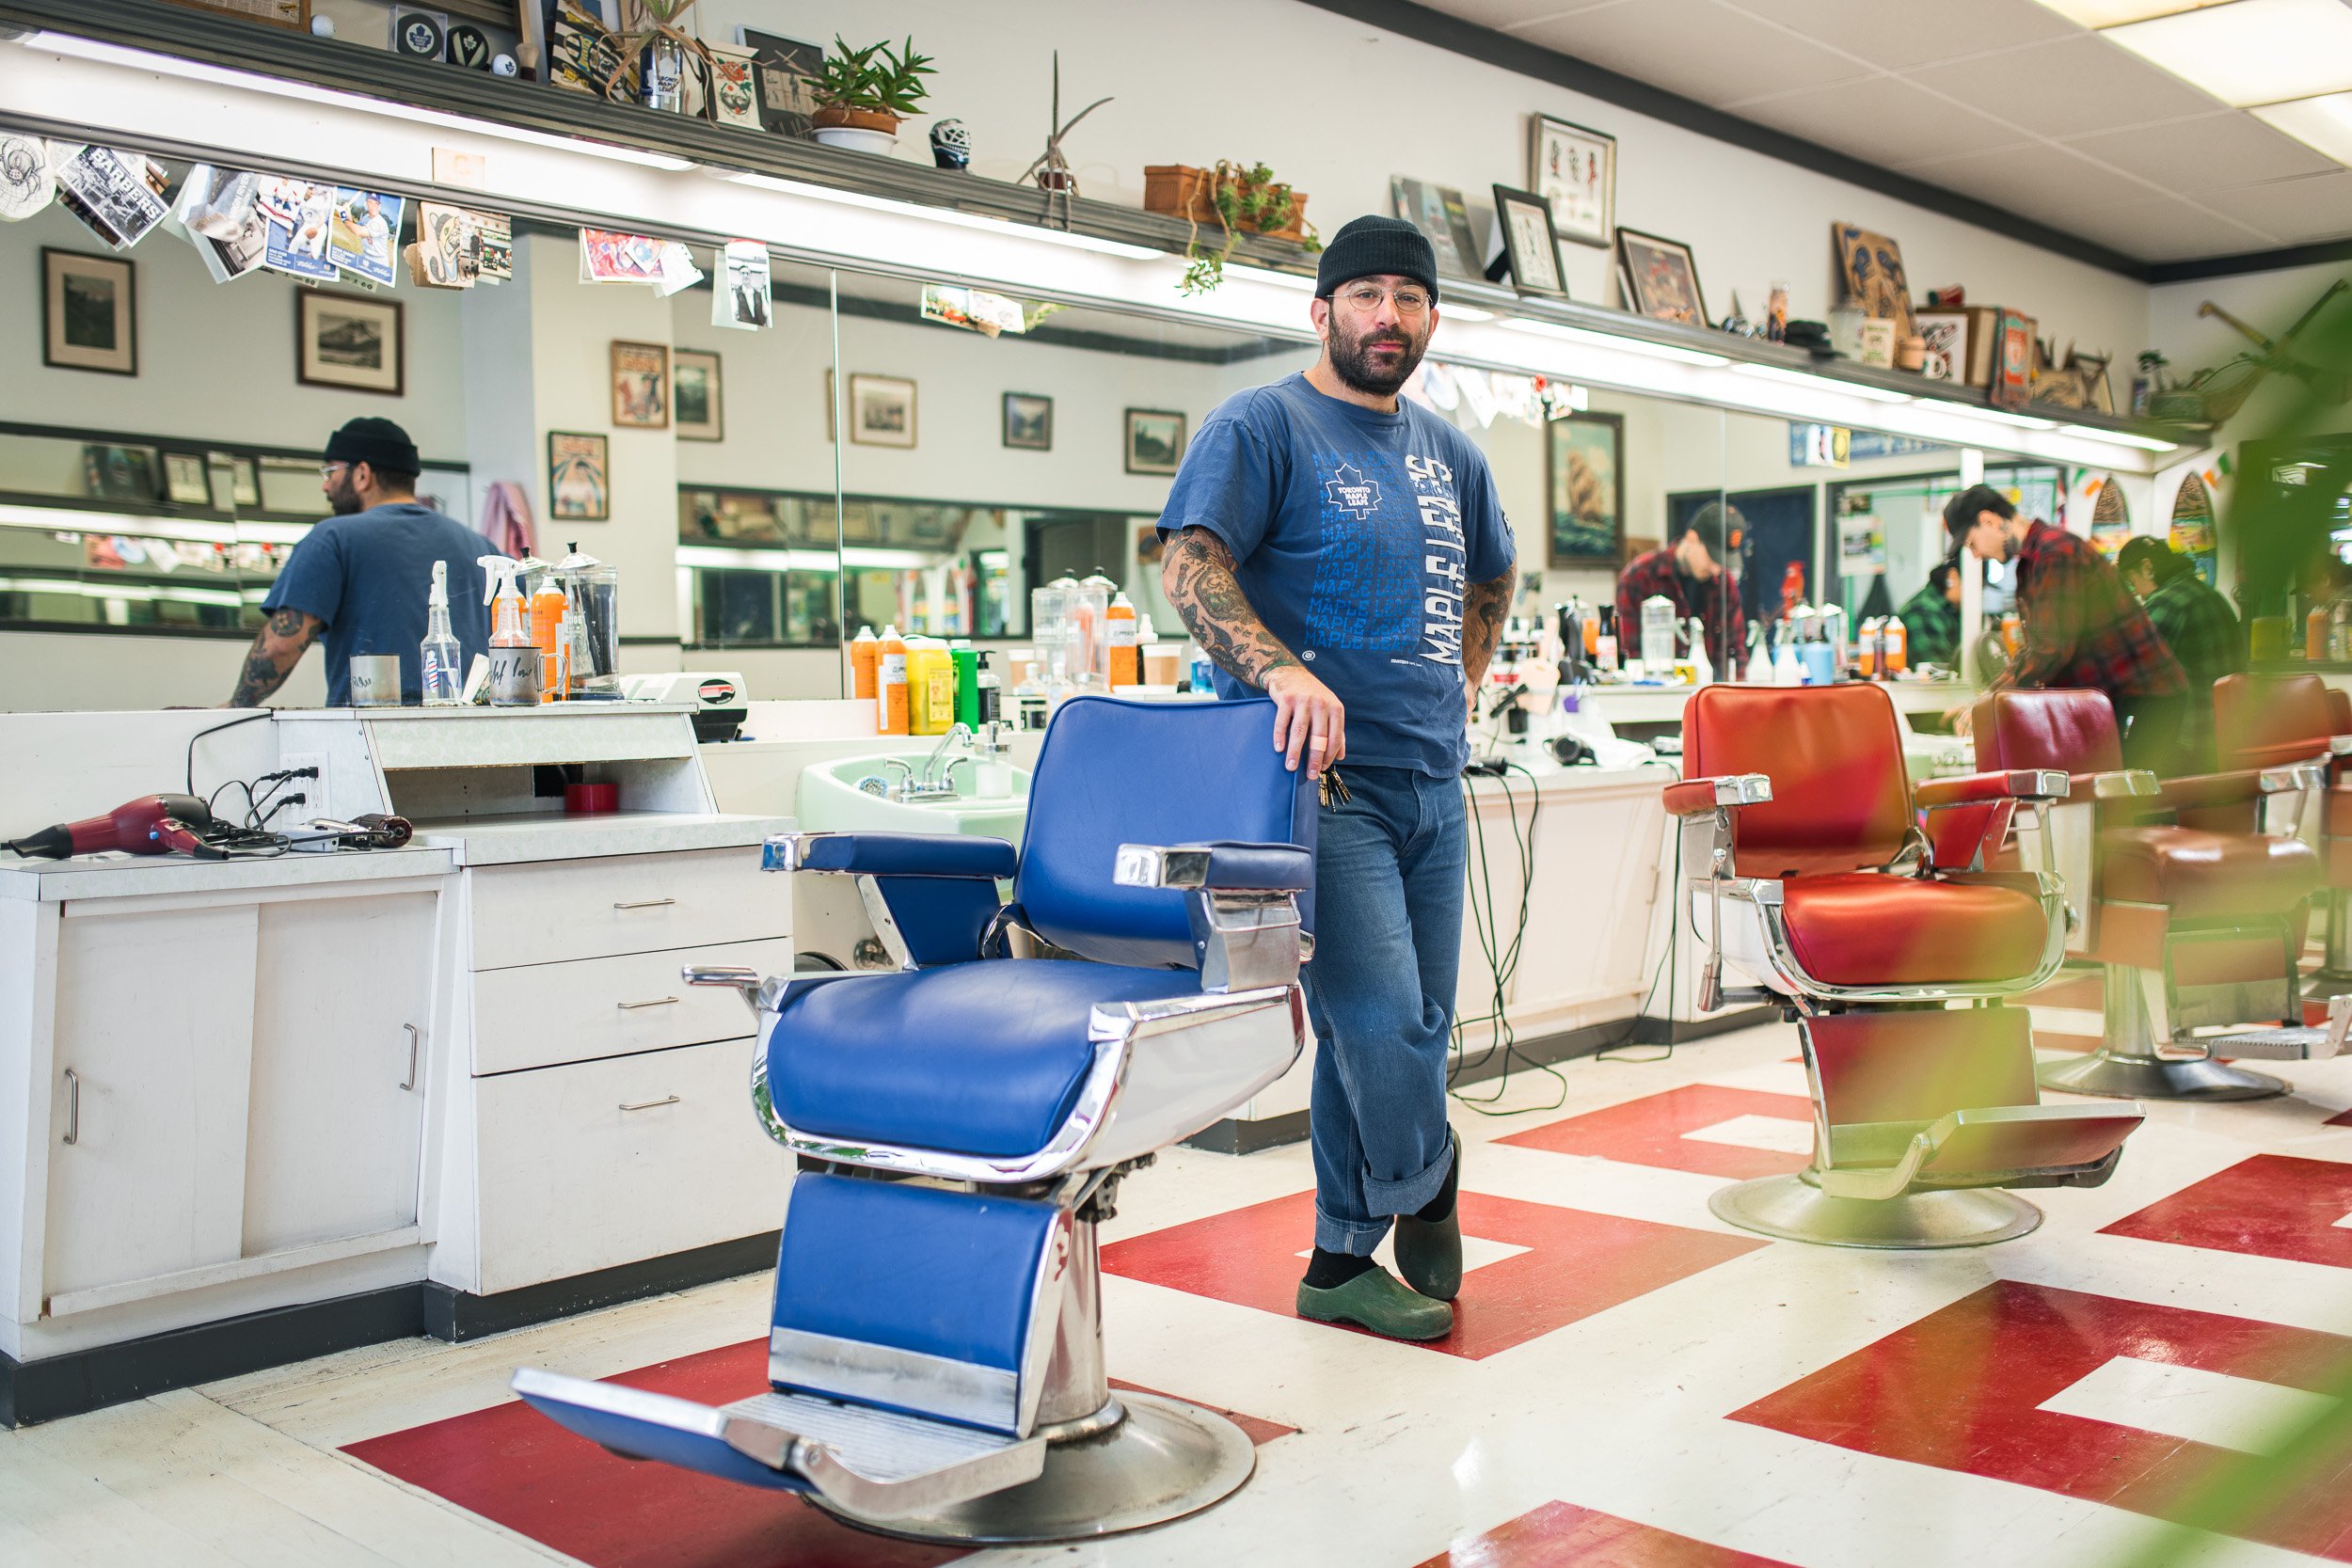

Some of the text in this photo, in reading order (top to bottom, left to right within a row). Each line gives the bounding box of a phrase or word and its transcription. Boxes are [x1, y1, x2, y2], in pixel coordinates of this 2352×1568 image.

[91, 147, 164, 220] BARBERS
[1338, 486, 1371, 495] TORONTO
[1347, 499, 1369, 507] LEAFS
[1307, 598, 1370, 617] MAPLE
[1304, 613, 1367, 636] MAPLE
